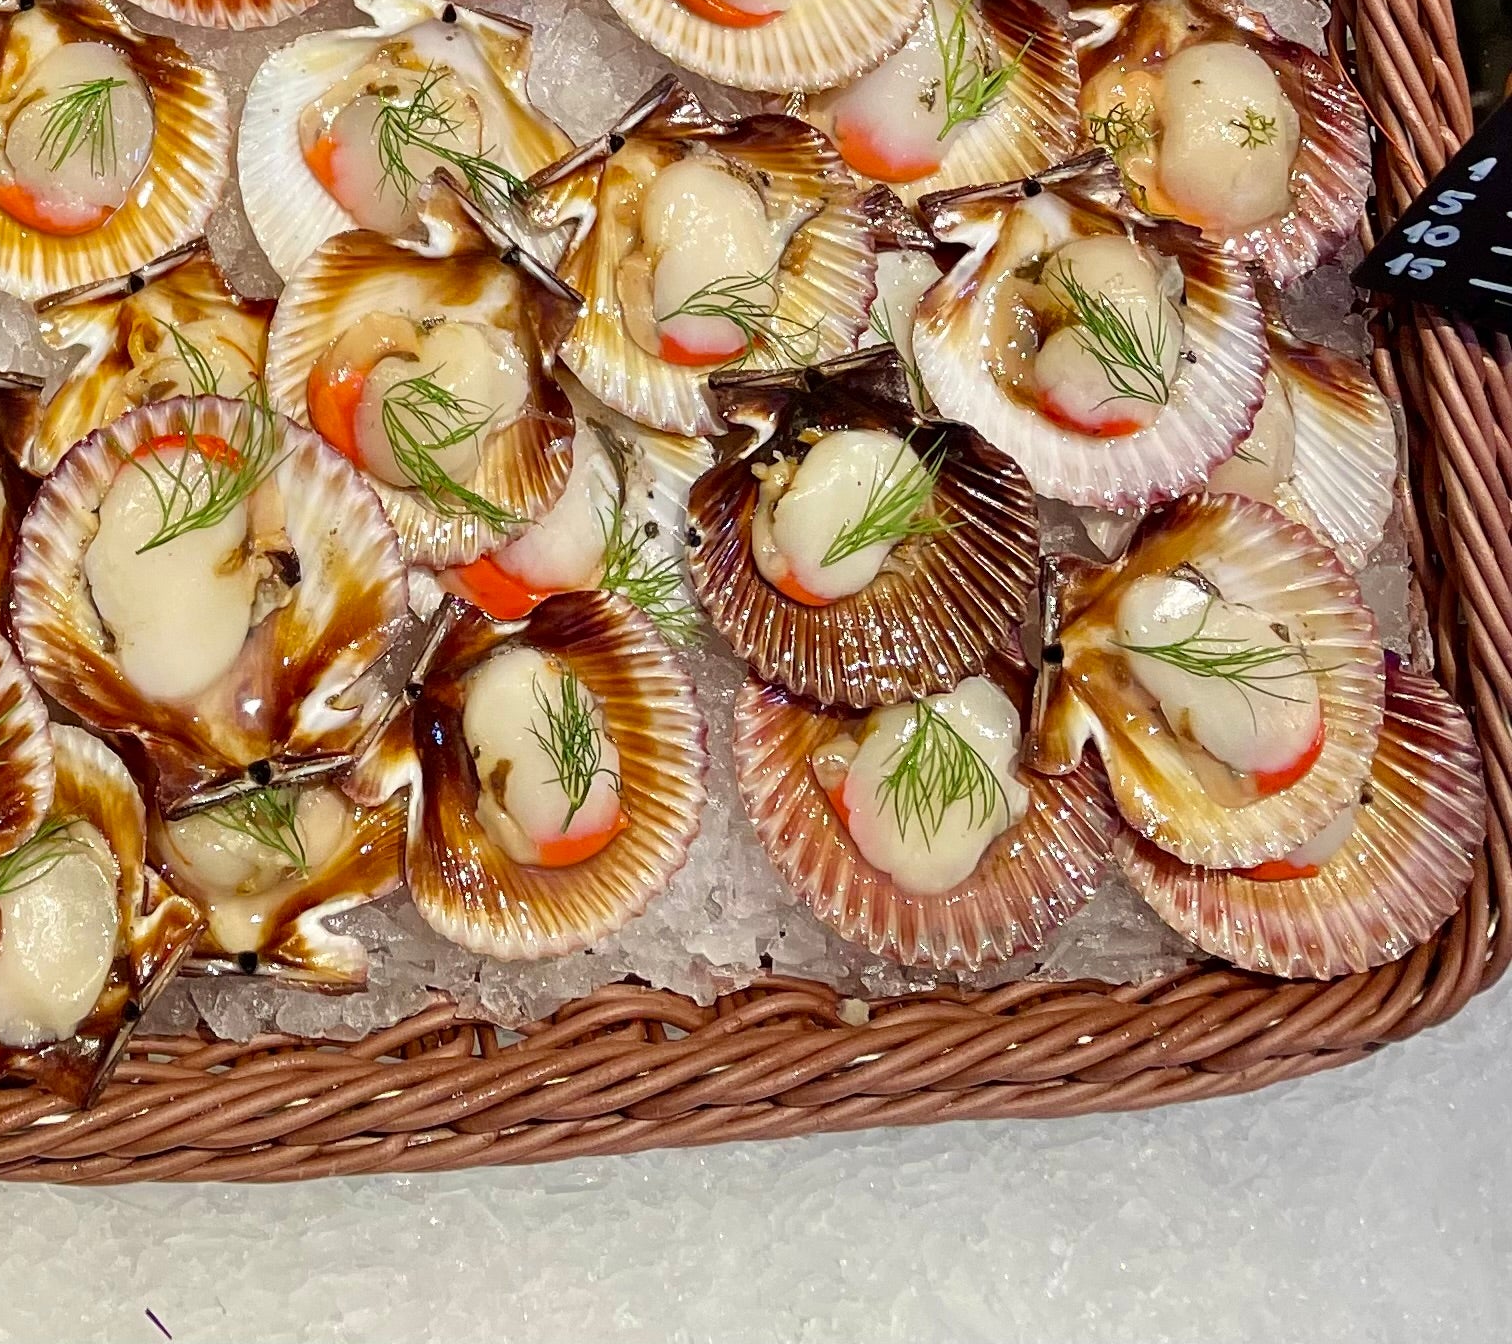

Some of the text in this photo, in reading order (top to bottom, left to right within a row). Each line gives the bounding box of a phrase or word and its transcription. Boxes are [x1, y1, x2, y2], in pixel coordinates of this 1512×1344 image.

[1468, 157, 1498, 182] 1
[1428, 190, 1476, 216] 5
[1403, 220, 1461, 248] 10
[1385, 252, 1447, 281] 15
